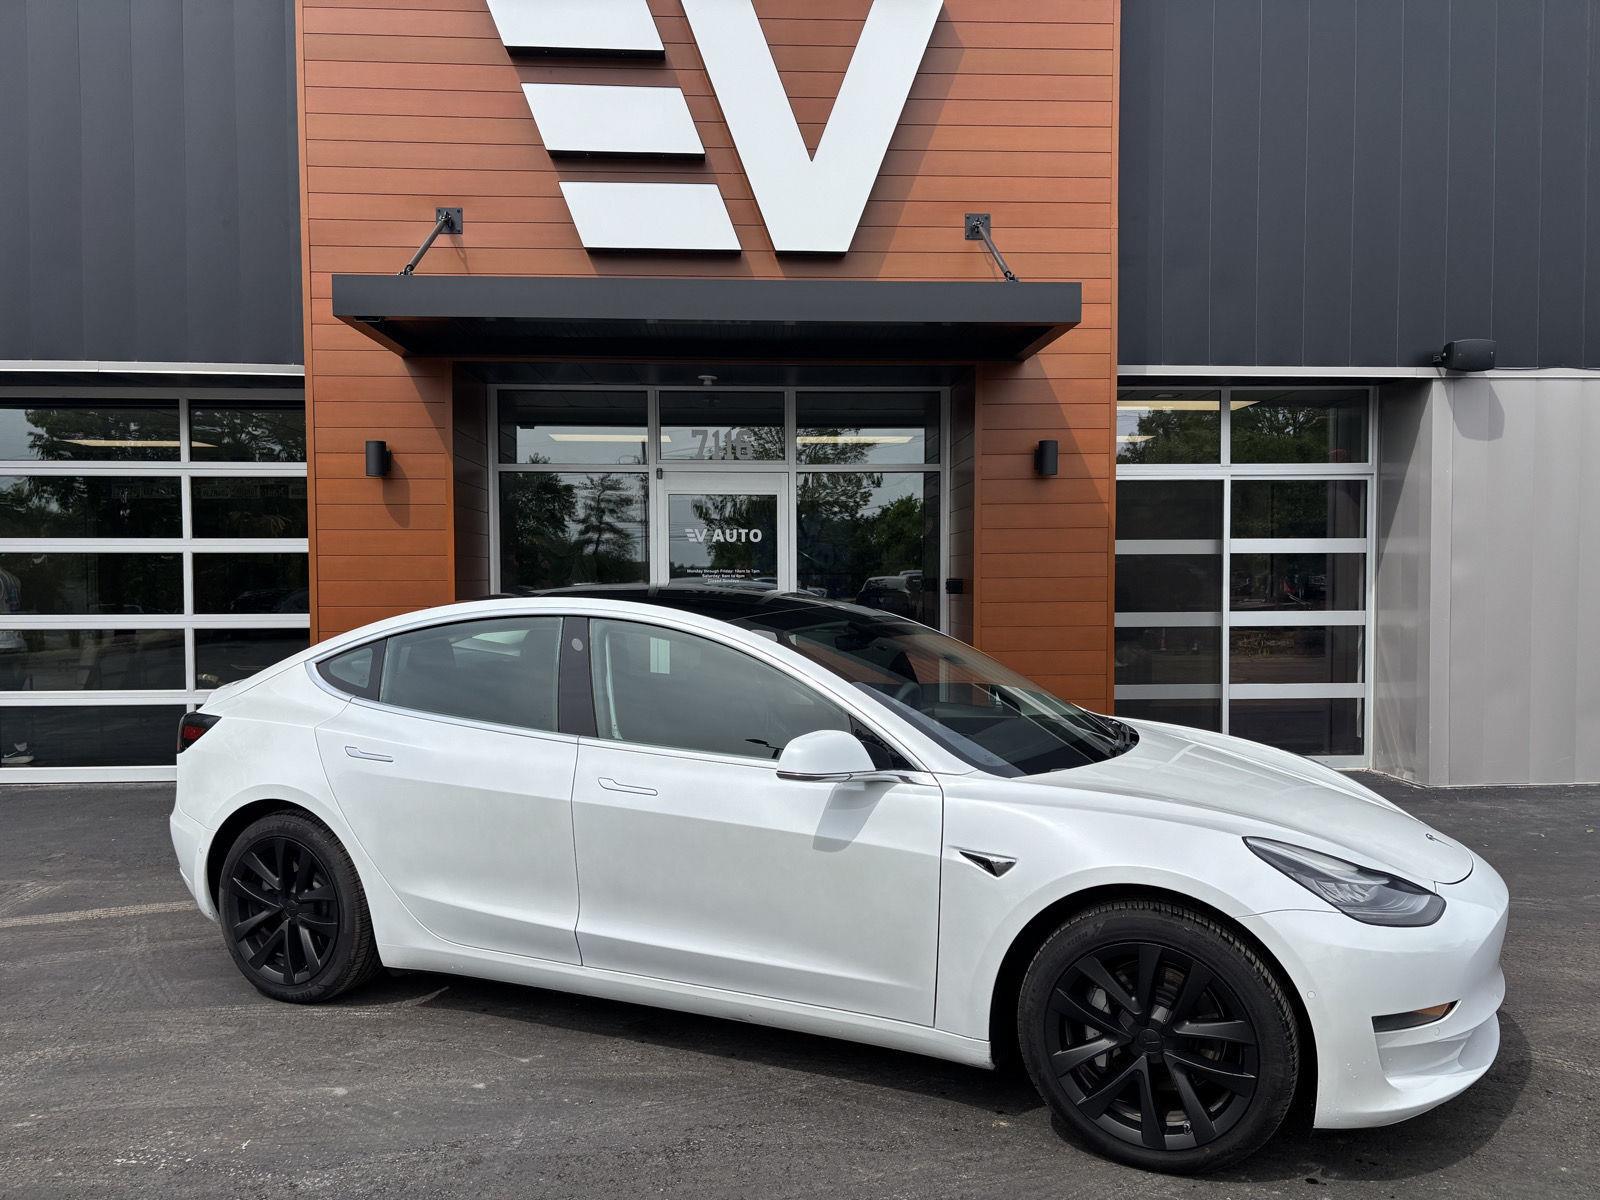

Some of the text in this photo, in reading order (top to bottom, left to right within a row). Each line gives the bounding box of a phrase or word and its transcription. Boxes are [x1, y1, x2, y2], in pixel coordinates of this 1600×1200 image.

[691, 430, 753, 460] 7116
[685, 529, 762, 542] EV AUTO
